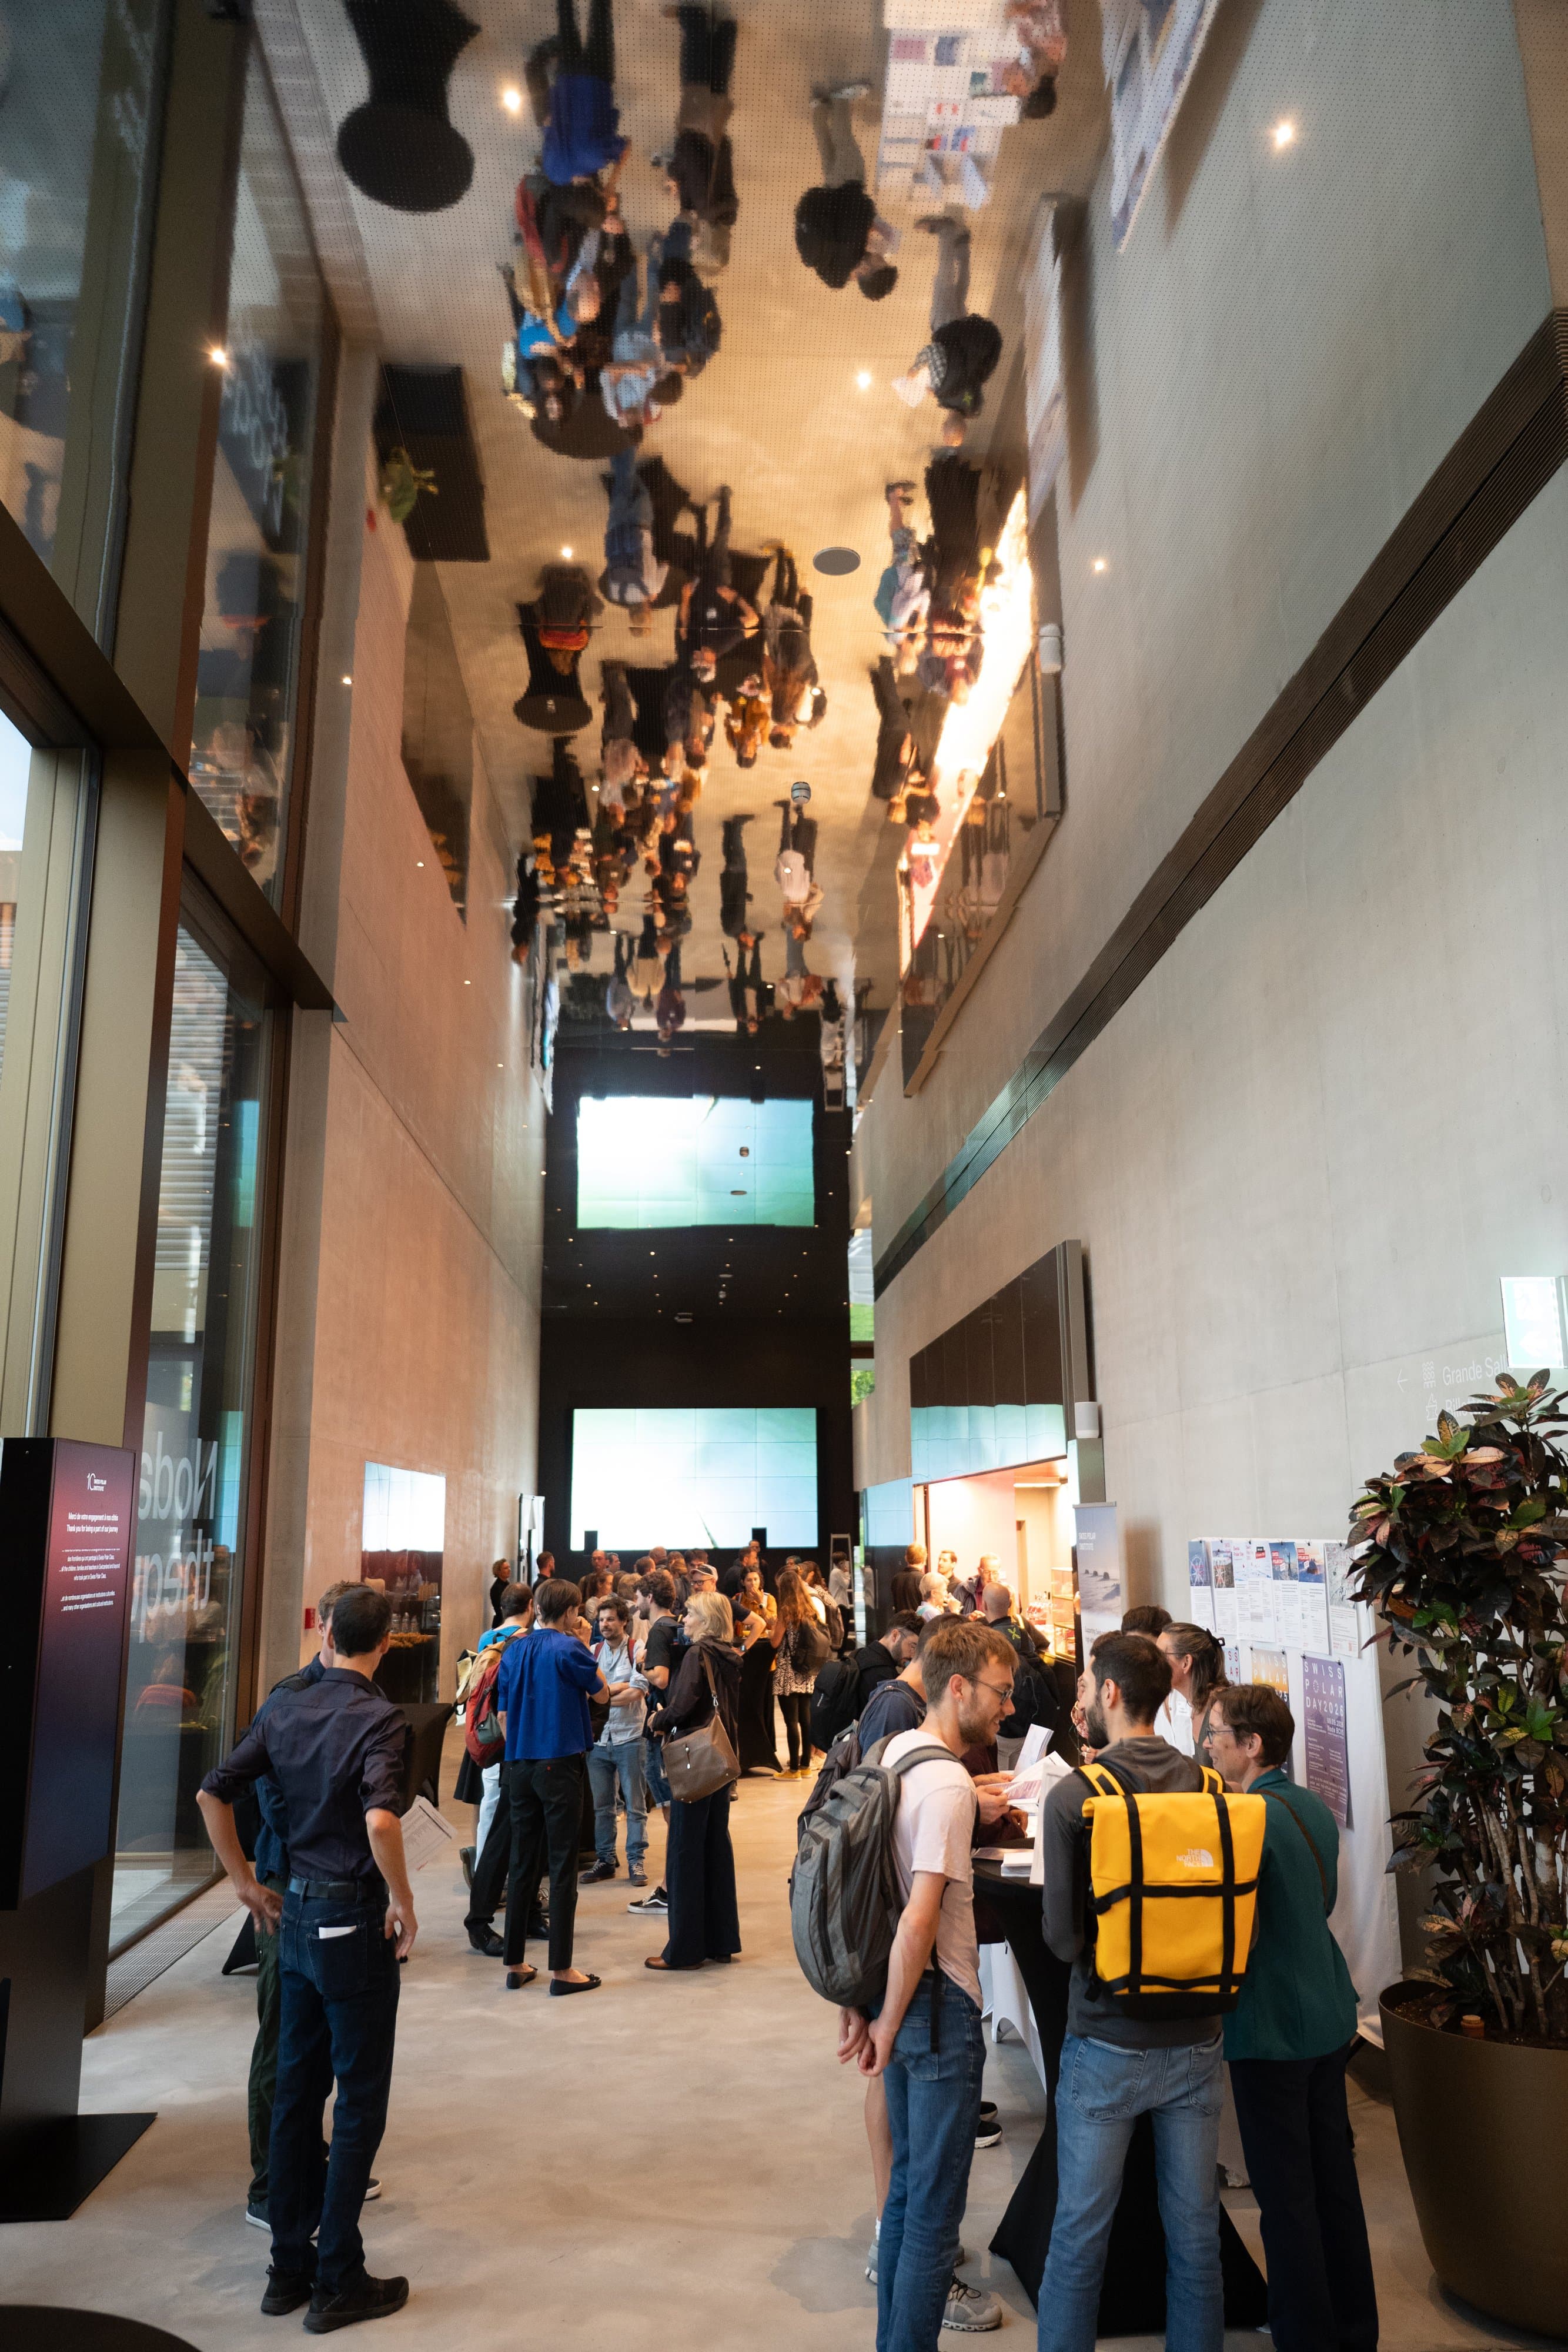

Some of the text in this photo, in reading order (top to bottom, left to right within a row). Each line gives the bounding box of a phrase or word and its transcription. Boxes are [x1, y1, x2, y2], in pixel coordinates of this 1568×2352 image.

[1443, 1359, 1482, 1386] Grande
[1304, 1661, 1342, 1680] SWISS
[1176, 1854, 1201, 1863] NORTH
